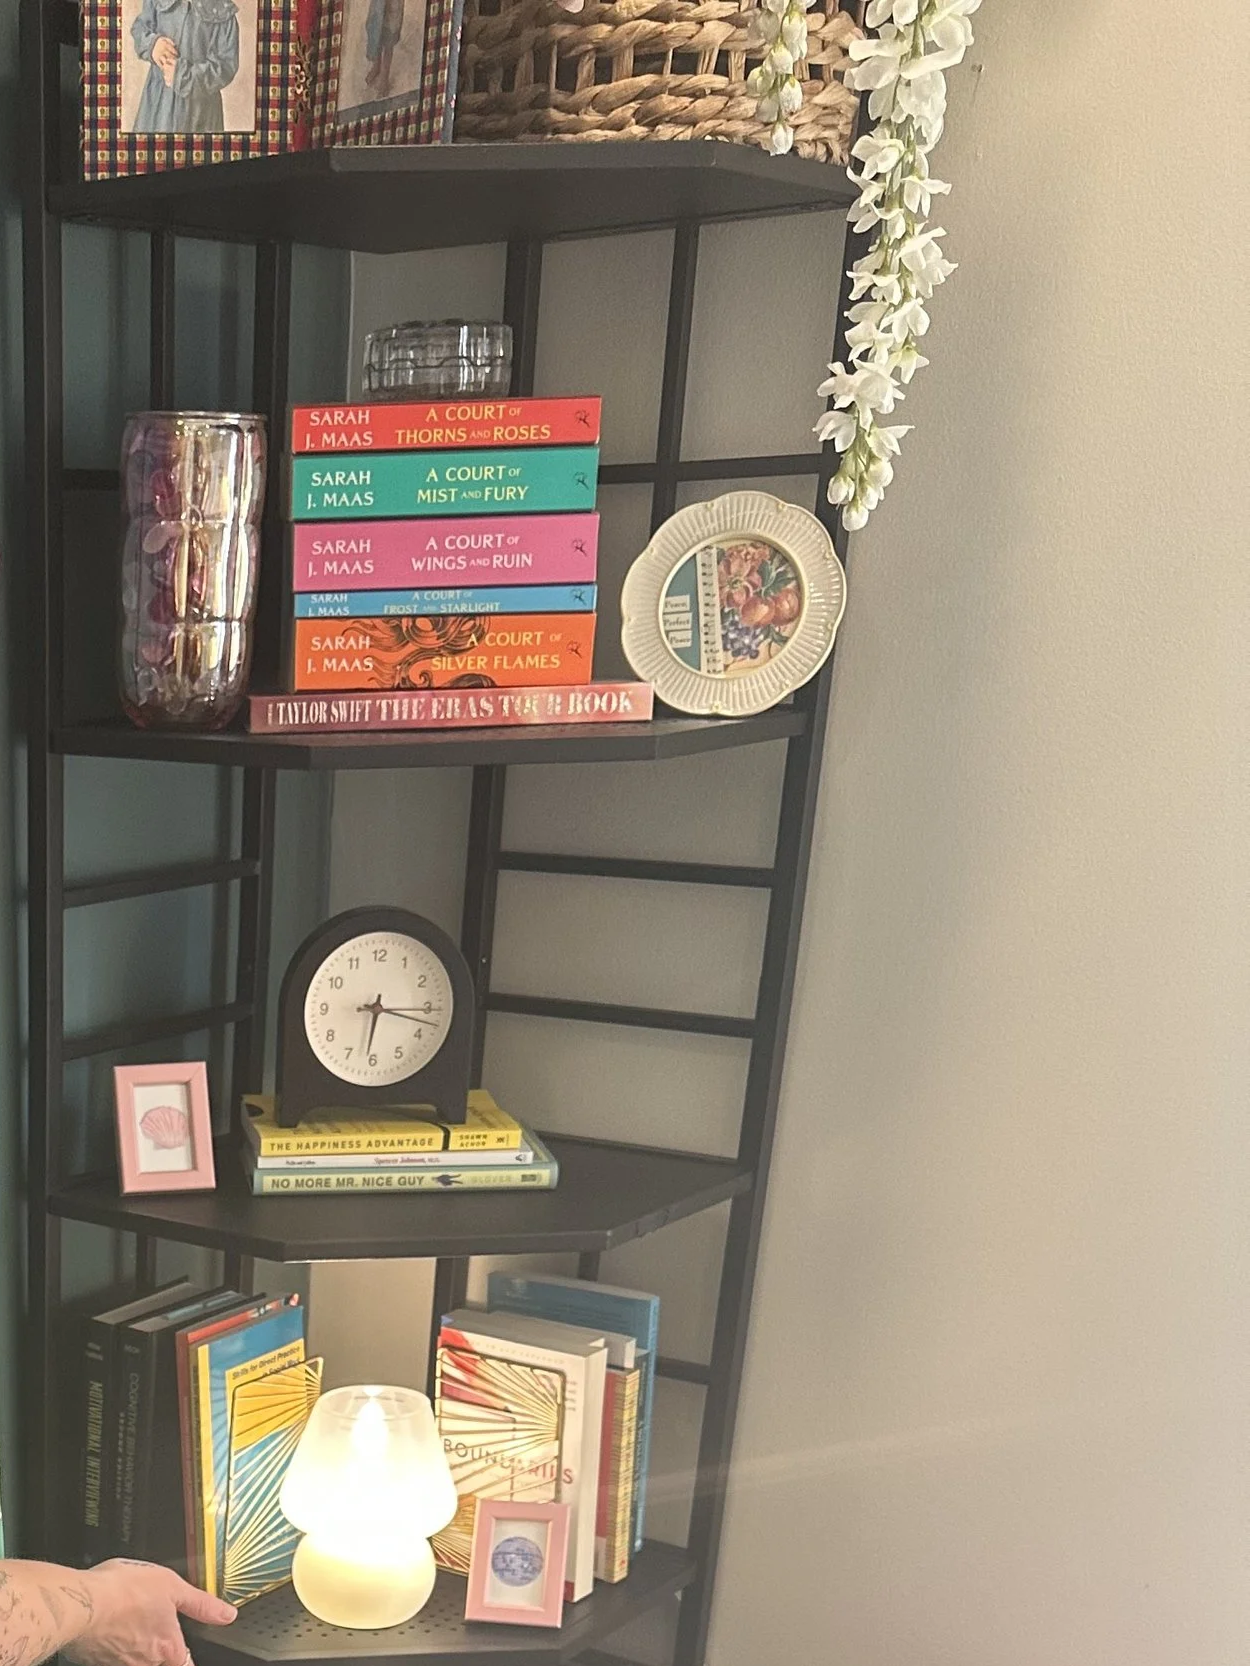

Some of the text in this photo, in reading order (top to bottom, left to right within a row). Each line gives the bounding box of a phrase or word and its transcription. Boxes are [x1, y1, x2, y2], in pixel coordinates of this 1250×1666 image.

[310, 410, 370, 427] SARAH
[426, 405, 522, 422] A COURT OF
[305, 431, 373, 450] J. MAAS
[395, 425, 551, 445] THORNS AND ROSES
[311, 471, 371, 487] SARAH
[426, 466, 522, 482] A COURT OF
[307, 491, 374, 510] J. MAAS
[417, 485, 529, 504] MIST AND FURY
[312, 539, 372, 556] SARAH
[426, 534, 520, 551] A COURT OF
[308, 560, 375, 578] J. MAAS
[412, 552, 533, 572] WINGS AND RUIN
[310, 594, 348, 604] SARAH
[412, 592, 420, 601] A
[424, 589, 461, 601] COURT
[318, 606, 350, 617] MAAS
[384, 604, 418, 615] FROST
[440, 602, 501, 613] STARLIGHT
[311, 636, 371, 651] SARAH
[467, 633, 479, 647] A
[486, 631, 543, 647] COURT
[307, 657, 374, 674] J. MAAS
[430, 653, 562, 671] SILVER FLAMES
[277, 701, 328, 725] TAYLOR
[330, 699, 372, 724] SWIFT
[376, 697, 426, 722] THE
[431, 695, 494, 720] ERAS
[498, 691, 563, 717] TOUR
[567, 690, 634, 715] BOOK
[348, 957, 360, 970] 11
[372, 949, 388, 963] 12
[402, 957, 408, 969] 1
[328, 976, 344, 989] 10
[418, 975, 427, 989] 2
[320, 1003, 329, 1016] 9
[423, 1002, 433, 1015] 3
[326, 1029, 335, 1042] 8
[413, 1028, 423, 1041] 4
[344, 1048, 354, 1061] 7
[368, 1054, 378, 1067] 6
[394, 1047, 404, 1060] 5
[270, 1138, 433, 1152] THE HAPPINESS ADVANTAGE
[271, 1175, 425, 1190] NO MORE MR. NICE GUY
[259, 1355, 277, 1369] Direct
[87, 1380, 103, 1452] MOTIVATIONAL
[85, 1455, 101, 1528] INTERVIEWING
